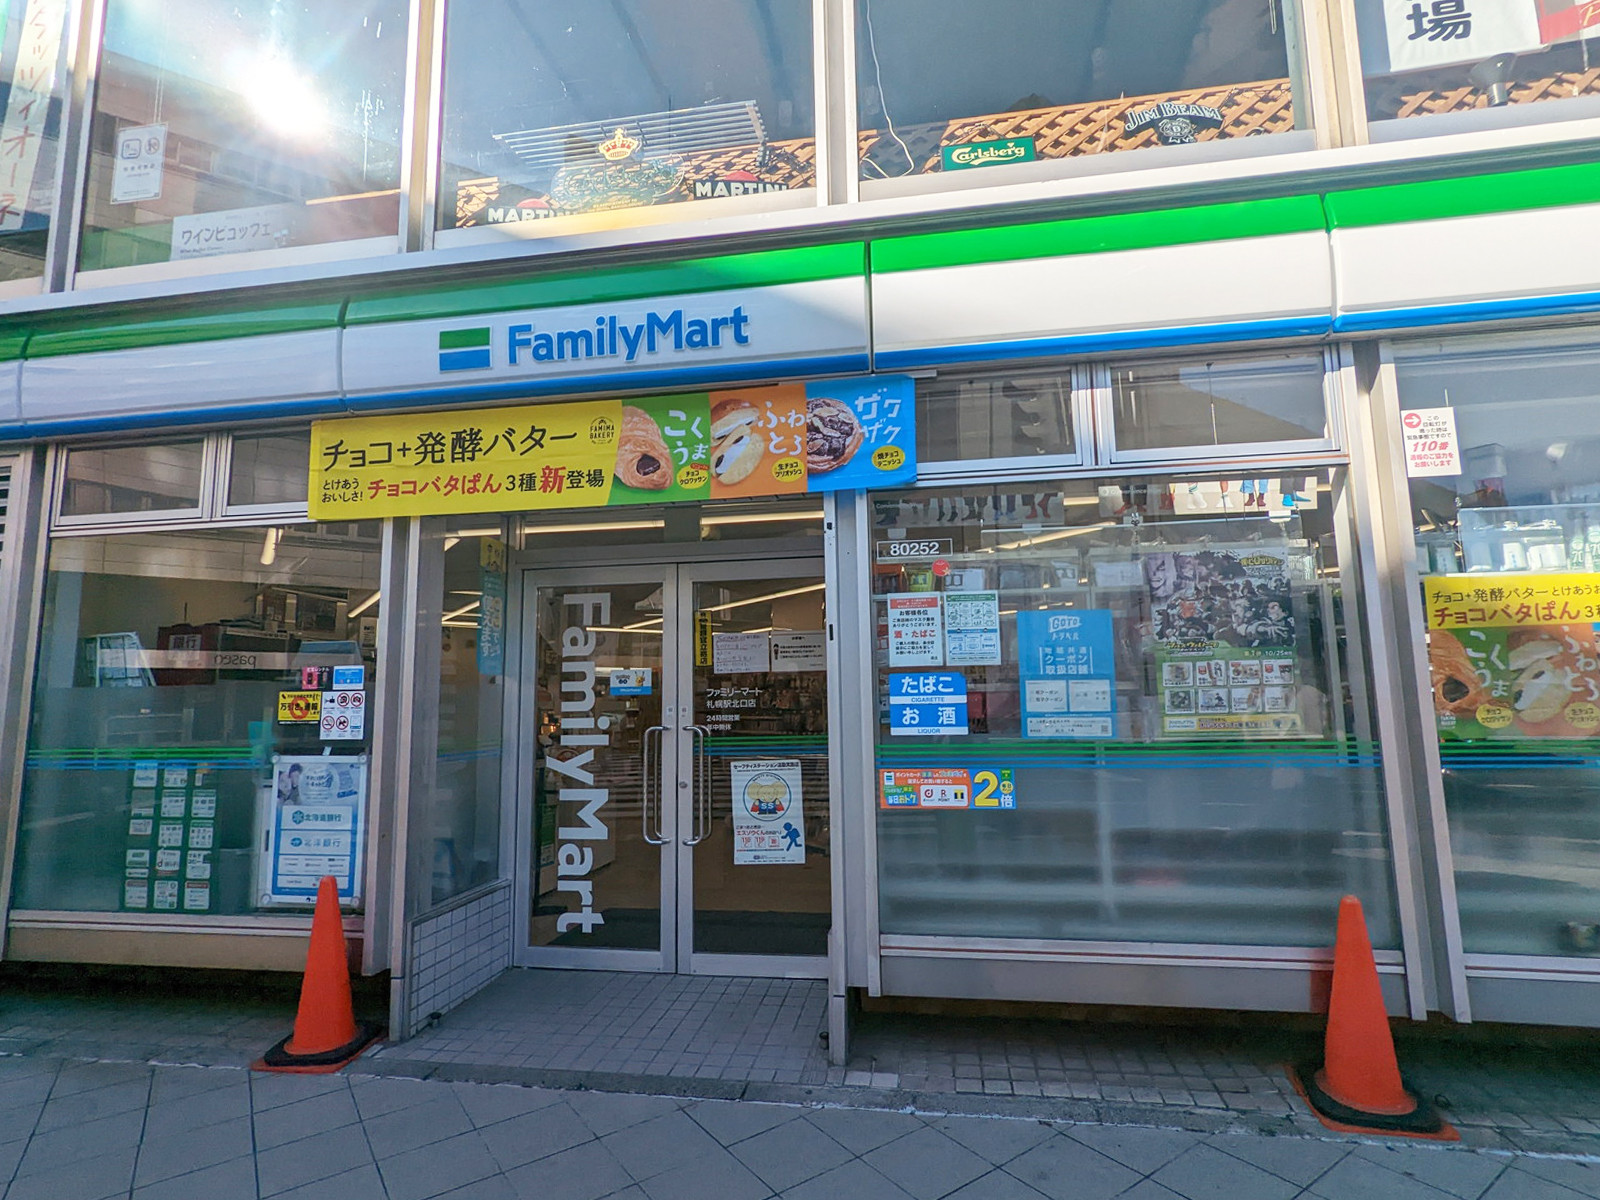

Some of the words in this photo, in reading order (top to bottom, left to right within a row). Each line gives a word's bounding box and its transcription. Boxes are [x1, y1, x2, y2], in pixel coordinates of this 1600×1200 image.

[1125, 107, 1160, 131] JIM
[1159, 101, 1223, 121] BEAM
[951, 143, 1025, 165] Carlsberg
[508, 305, 749, 365] FamilyMart
[757, 400, 806, 429] ふわ
[854, 387, 902, 420] ザク
[664, 409, 704, 439] こく
[322, 424, 578, 472] チョコ+発酵バター
[673, 441, 709, 465] うま
[768, 431, 803, 456] とろ
[1412, 440, 1450, 452] 110番
[323, 477, 359, 490] とけあう
[367, 473, 502, 500] チョコバタぱん
[321, 492, 363, 503] おいしさ!
[889, 542, 940, 556] 80252
[1434, 600, 1581, 627] チョコバタぱん
[1045, 655, 1088, 664] クーポン
[705, 687, 763, 698] ファミリーマート
[901, 676, 954, 694] たばこ
[546, 592, 612, 934] FamilyMart
[973, 770, 999, 807] 2
[1000, 793, 1014, 808] 倍
